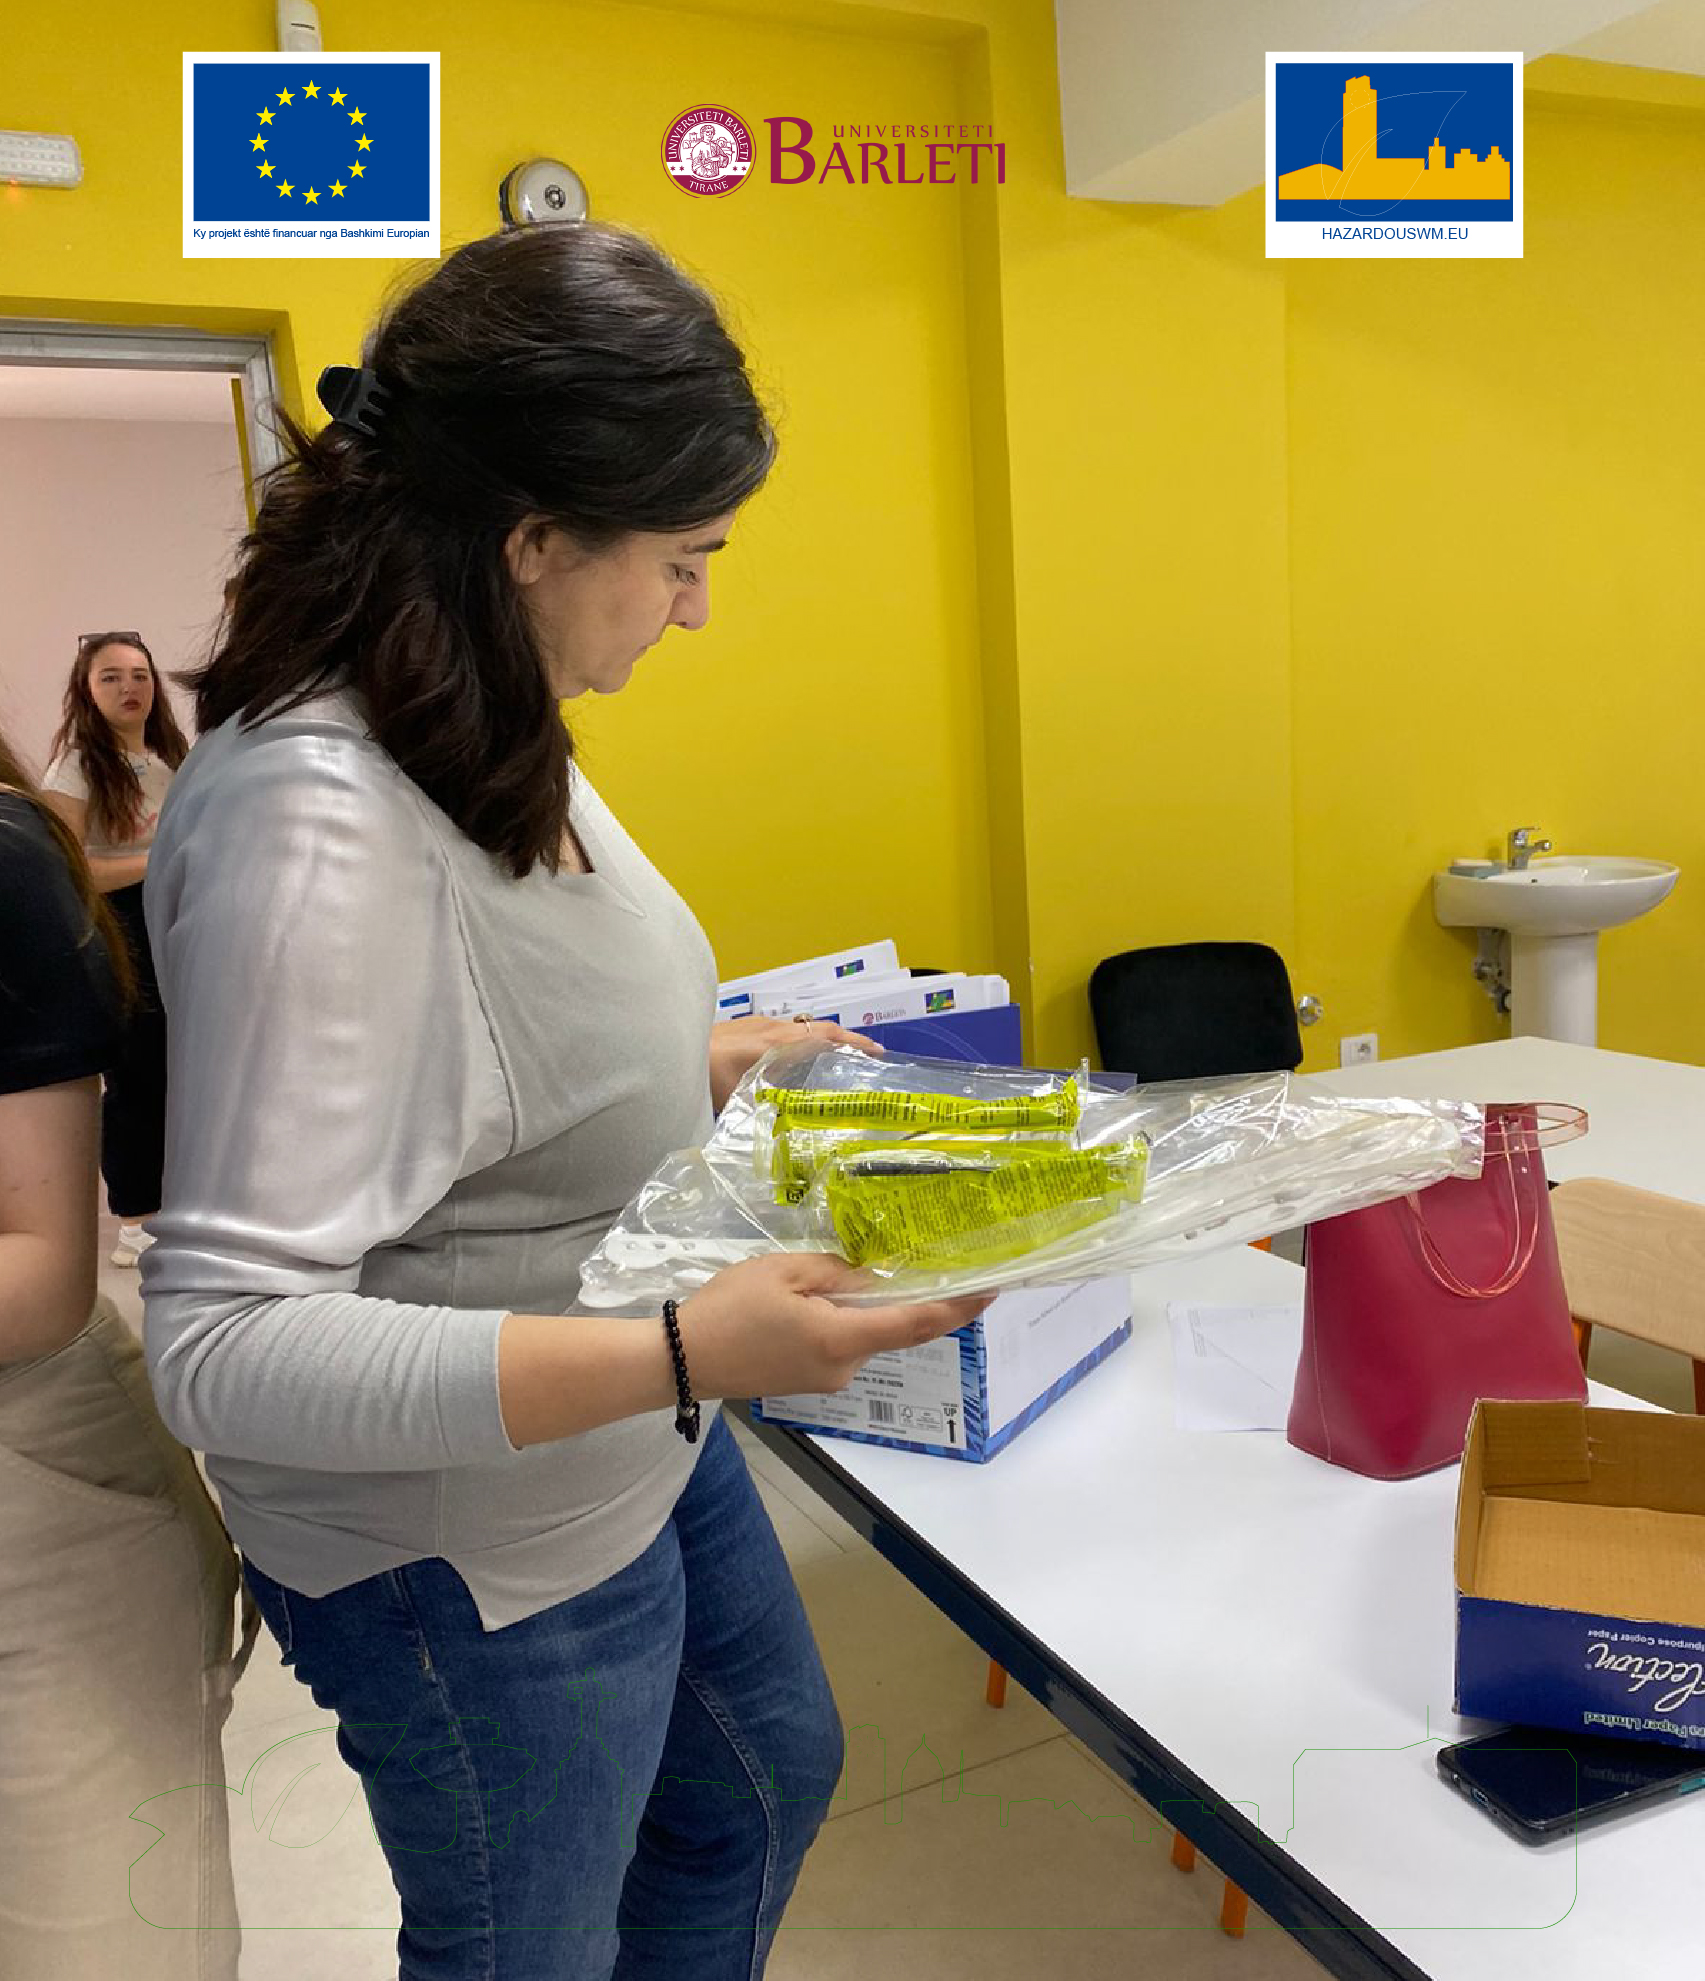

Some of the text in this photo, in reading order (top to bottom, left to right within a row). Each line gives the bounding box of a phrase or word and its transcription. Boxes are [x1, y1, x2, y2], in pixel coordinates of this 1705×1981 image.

[943, 1407, 958, 1417] UP
[1587, 1630, 1619, 1641] Paper
[1620, 1634, 1656, 1645] Copier
[1587, 1643, 1705, 1712] lection
[1584, 1711, 1642, 1731] Limited
